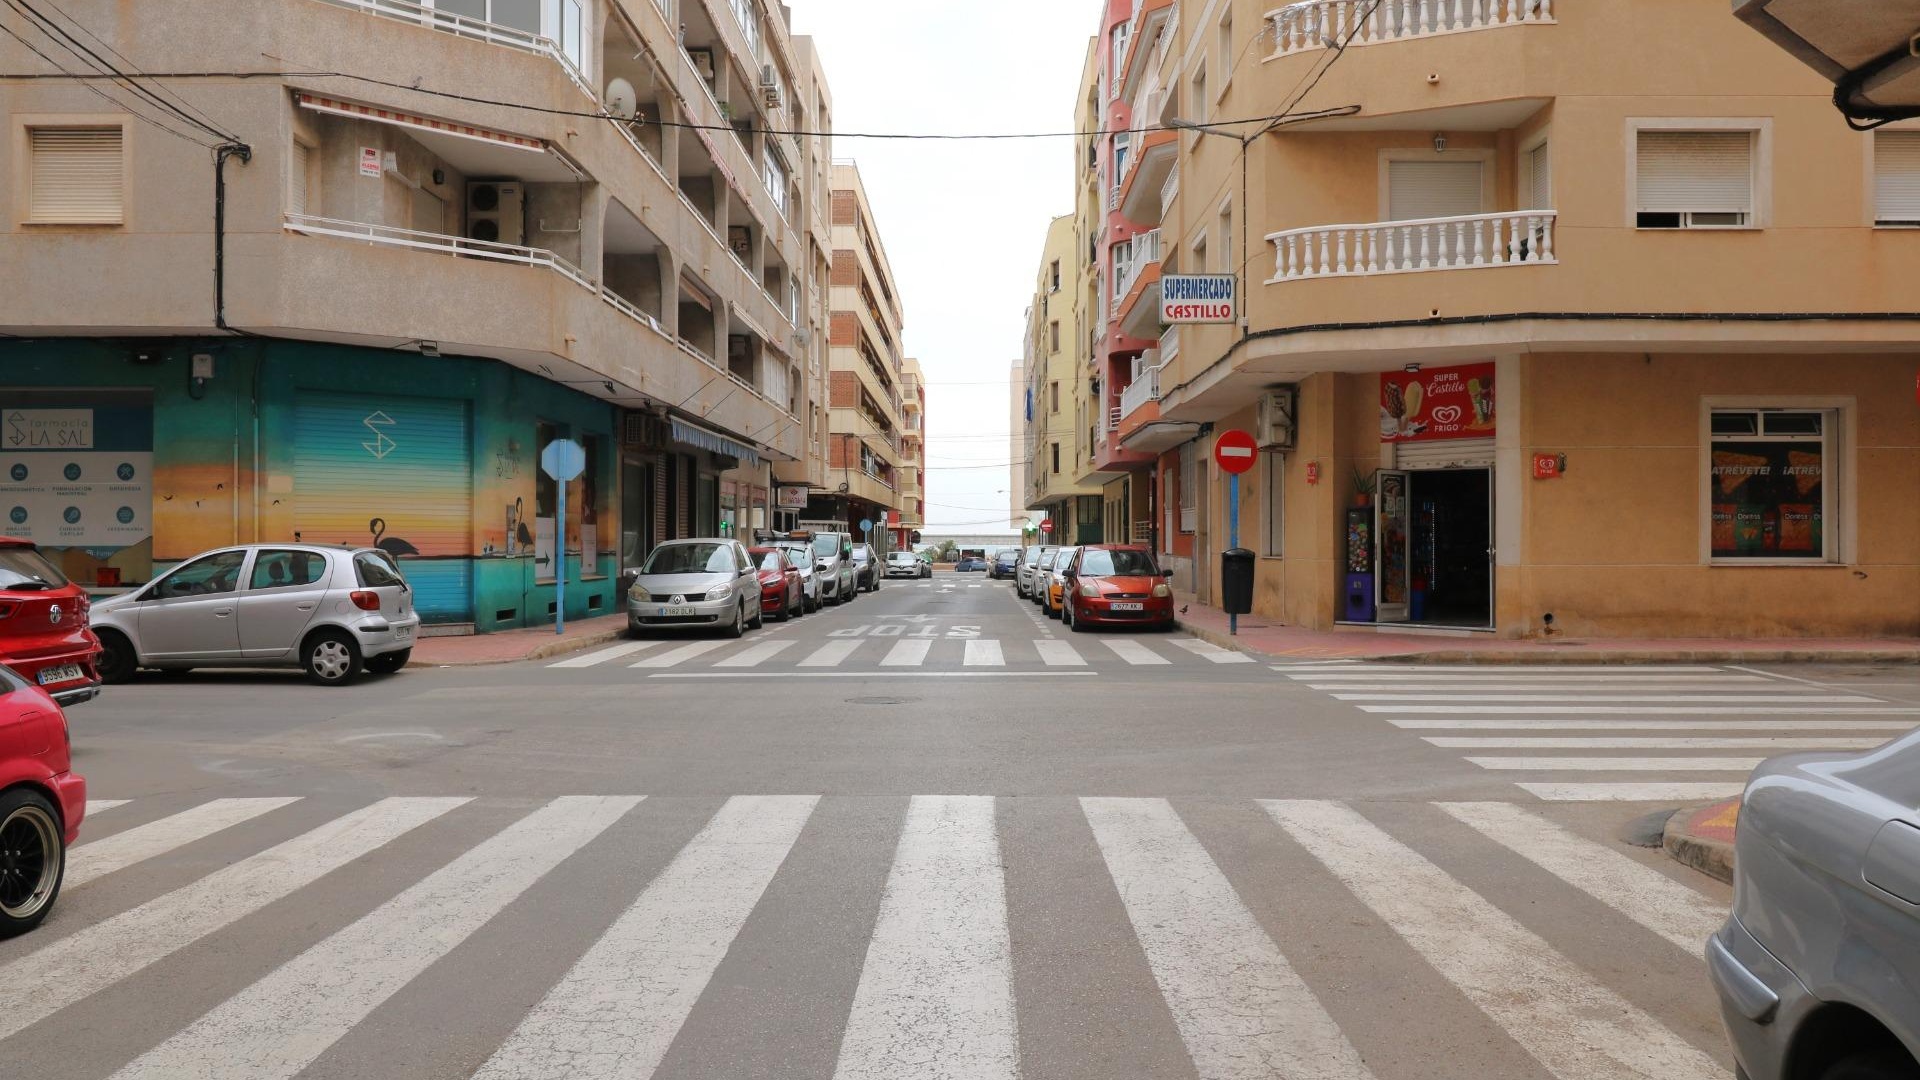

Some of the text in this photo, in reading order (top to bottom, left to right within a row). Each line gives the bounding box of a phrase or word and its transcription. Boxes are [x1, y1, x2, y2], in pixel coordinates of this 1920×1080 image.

[1164, 278, 1232, 300] SUPERMERCADO
[1165, 304, 1231, 319] CASTILLO
[1433, 373, 1459, 382] SUPER
[1426, 381, 1465, 397] Castillo
[30, 419, 88, 428] farmacia
[1434, 424, 1459, 433] FRIGO
[31, 429, 88, 446] LA SAL
[826, 624, 981, 639] STOP
